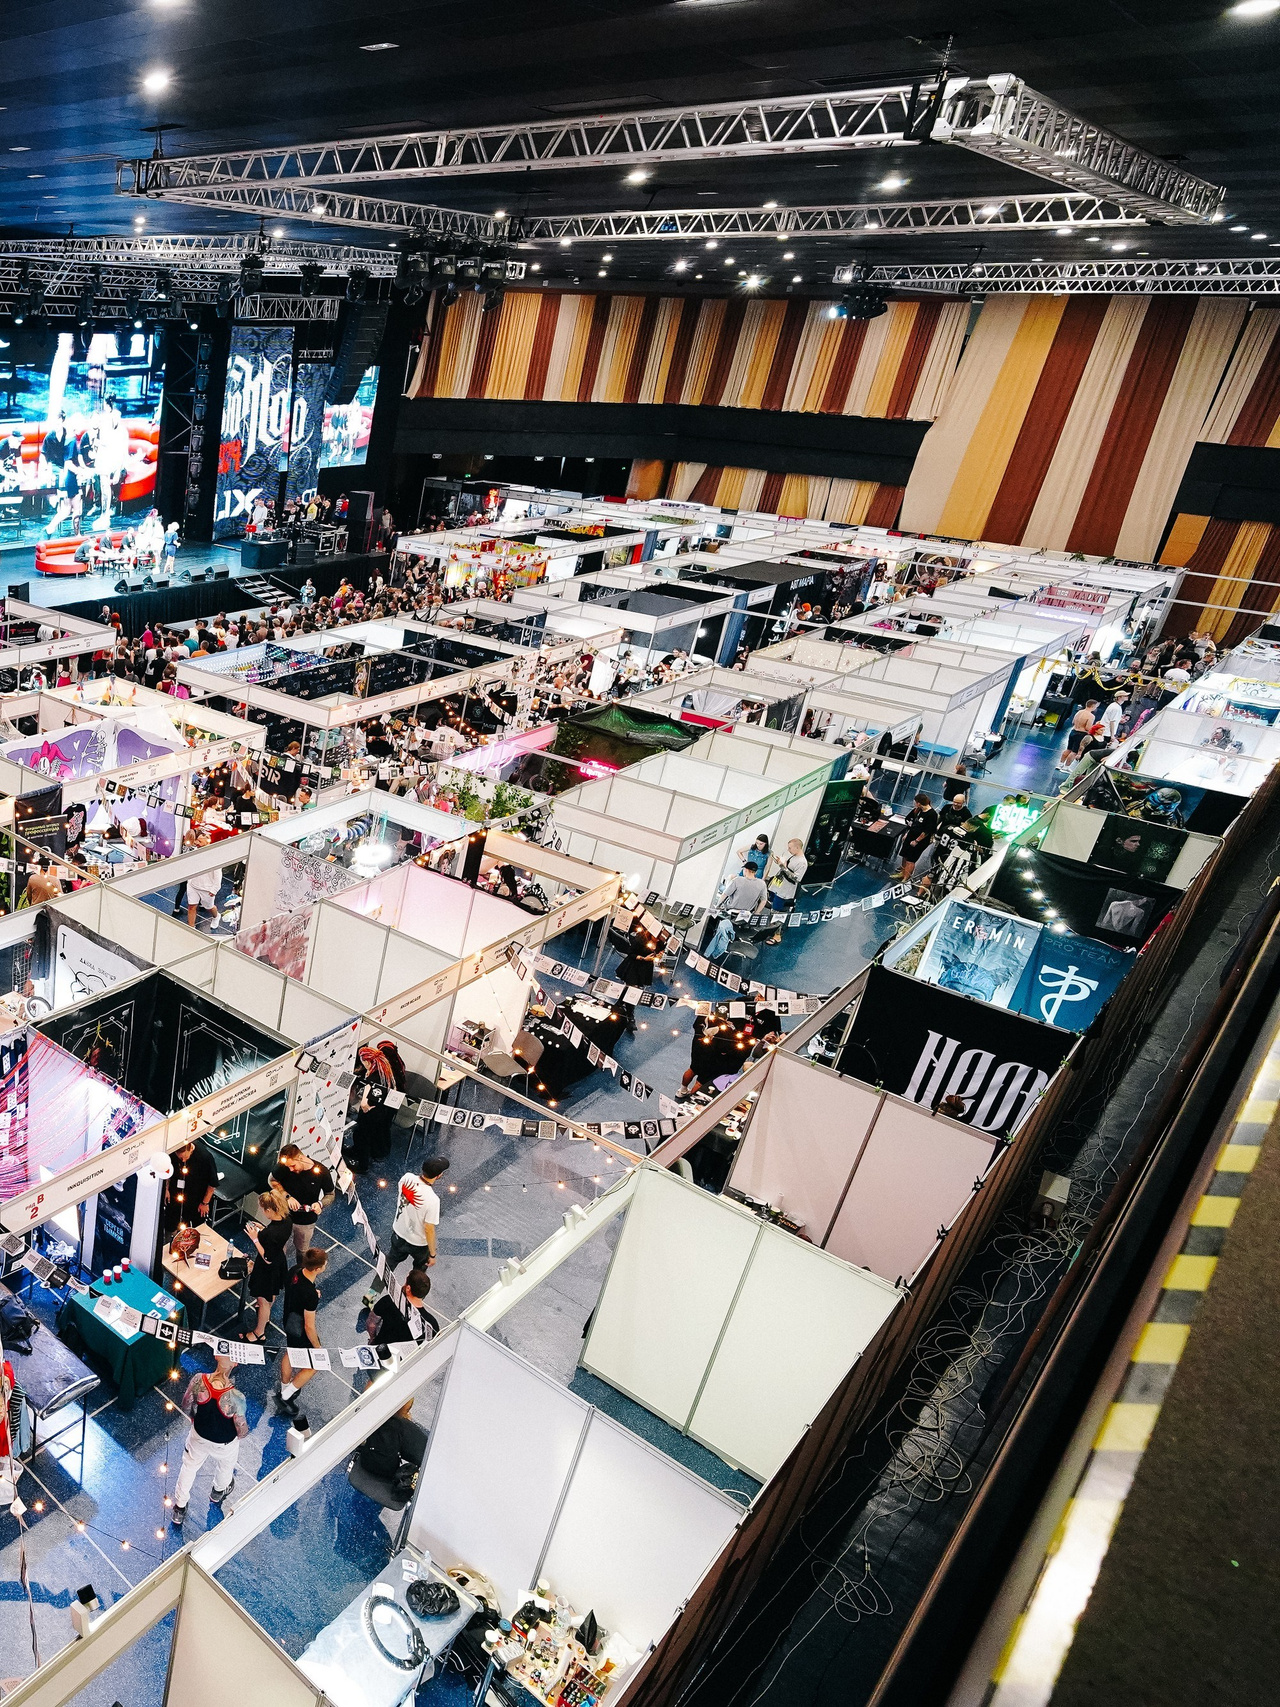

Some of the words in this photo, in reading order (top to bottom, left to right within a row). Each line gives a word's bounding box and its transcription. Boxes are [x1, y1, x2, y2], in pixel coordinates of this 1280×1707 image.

[1043, 937, 1074, 953] PRO
[1078, 947, 1120, 965] TEAM
[30, 1206, 39, 1220] 2
